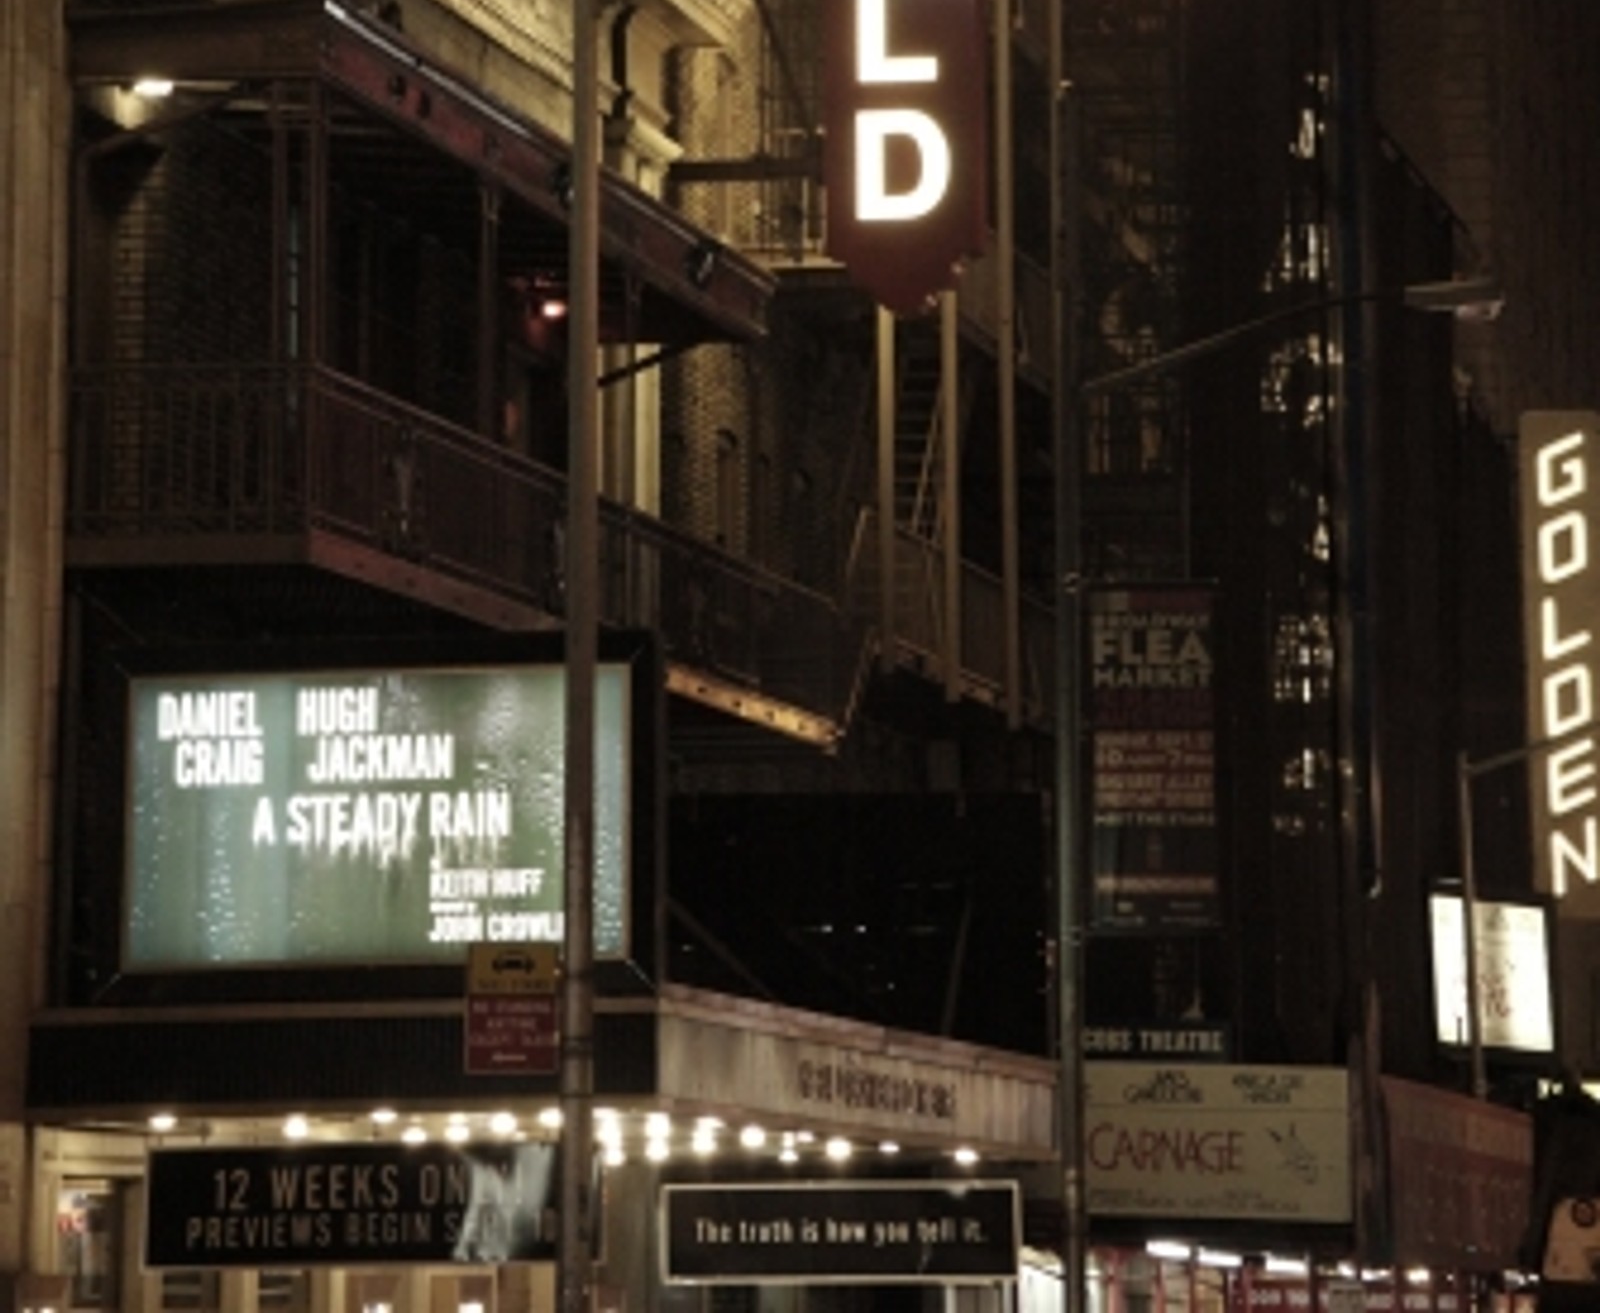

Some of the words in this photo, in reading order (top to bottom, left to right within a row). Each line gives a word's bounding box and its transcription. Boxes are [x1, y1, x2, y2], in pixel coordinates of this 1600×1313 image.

[1092, 628, 1214, 665] FLEA
[1536, 432, 1600, 899] GOLDEN
[157, 691, 264, 740] DANIEL
[296, 687, 378, 736] HUGH
[175, 740, 264, 788] CRAIG
[306, 733, 454, 783] JACKMAN
[252, 796, 277, 846] A
[286, 792, 422, 850] STEADY
[429, 789, 511, 839] RAIN
[1139, 1029, 1225, 1053] THEATRE
[1088, 1120, 1245, 1174] CARNAGE
[212, 1168, 251, 1212] 12
[269, 1163, 400, 1210] WEEKS
[185, 1212, 332, 1251] PREVIEWS
[343, 1208, 432, 1248] BEGIN
[696, 1218, 732, 1244] The
[739, 1220, 795, 1244] truth
[800, 1216, 819, 1244] is
[826, 1217, 867, 1243] how
[873, 1222, 910, 1248] you
[916, 1218, 956, 1244] tell
